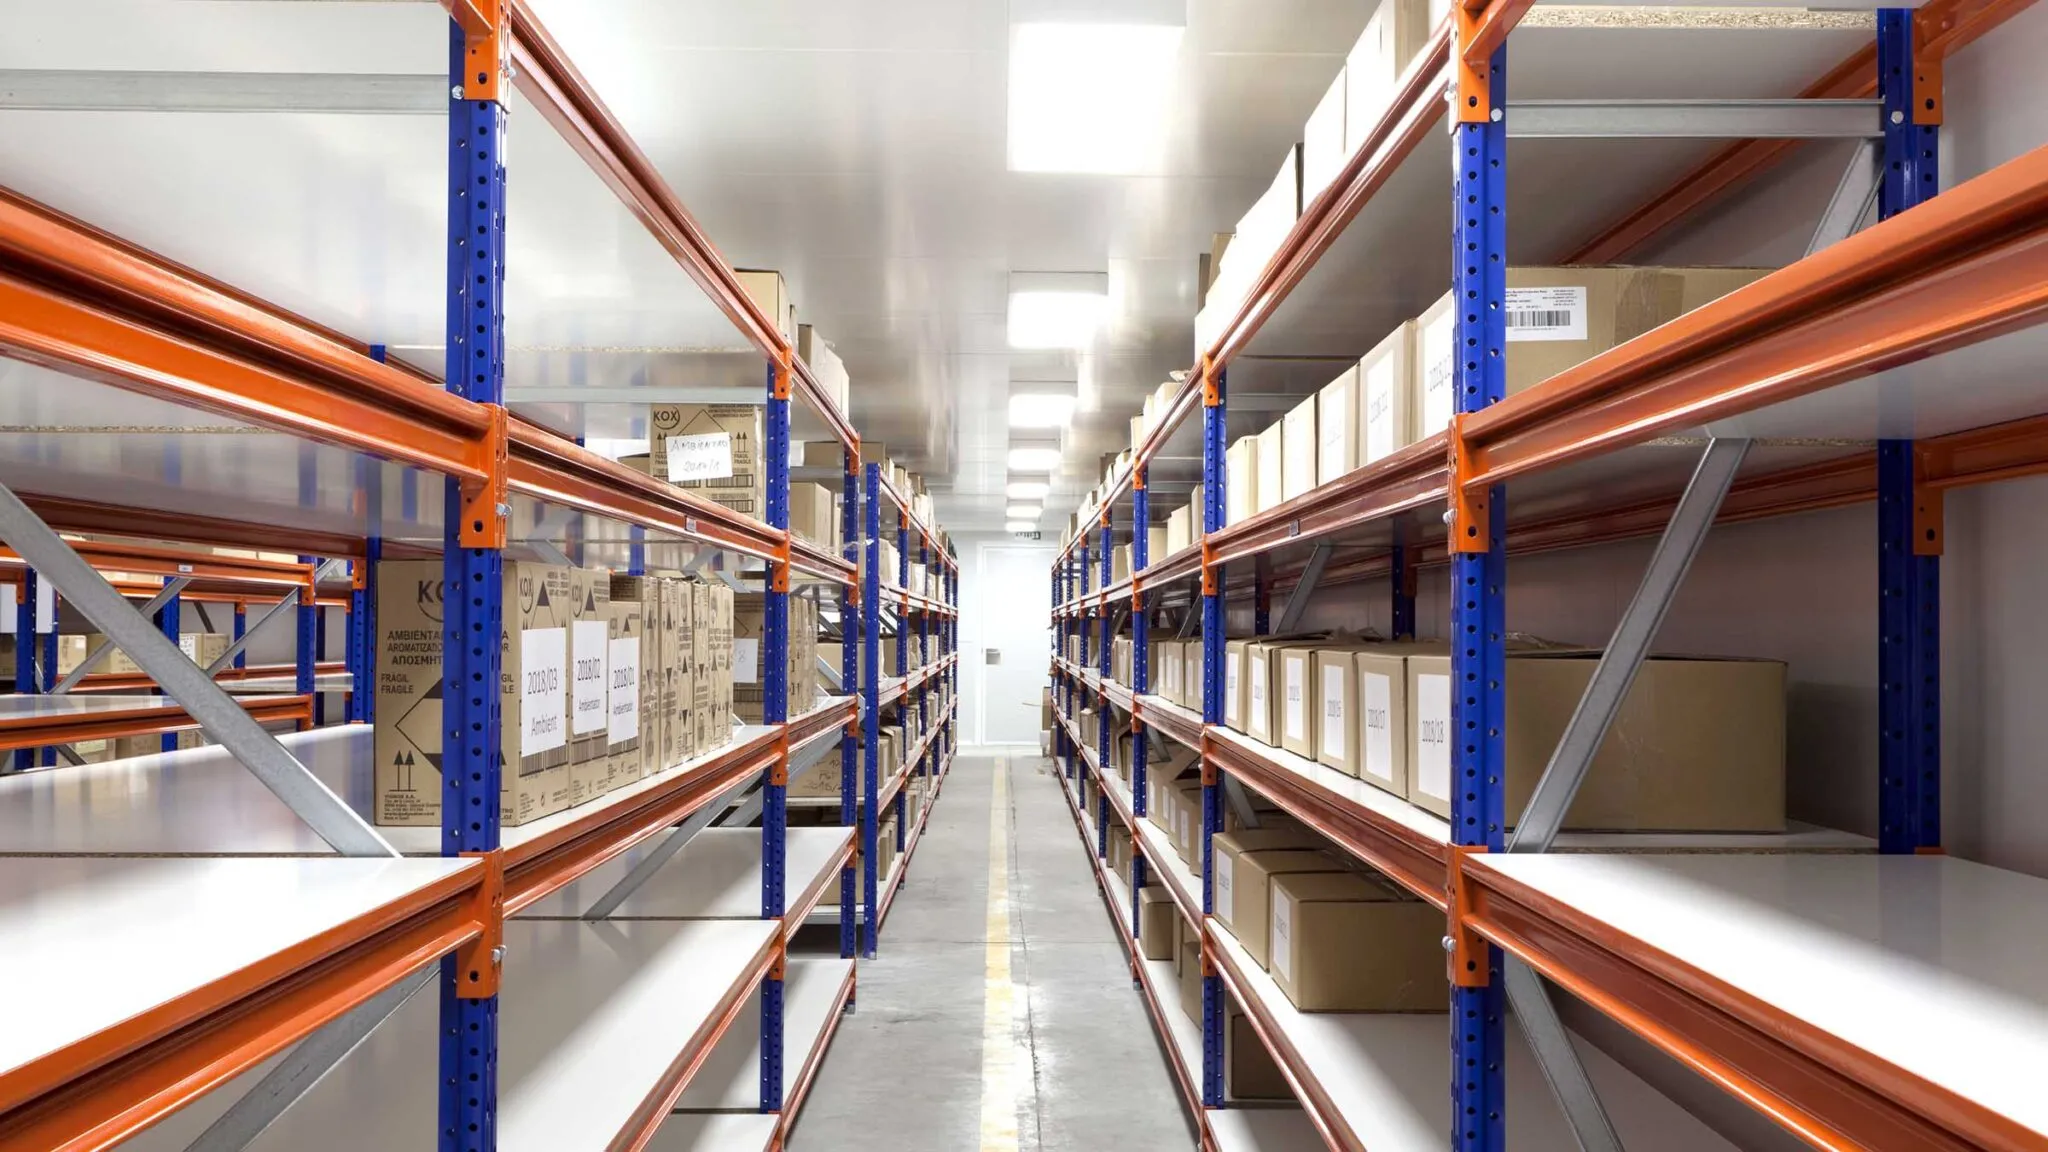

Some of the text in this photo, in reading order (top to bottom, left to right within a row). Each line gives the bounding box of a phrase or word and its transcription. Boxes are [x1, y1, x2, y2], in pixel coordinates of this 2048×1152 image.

[653, 410, 678, 422] KOX
[519, 576, 534, 599] KOX
[387, 630, 443, 641] AMBIENTA
[387, 642, 443, 653] AROMATIZADO
[391, 655, 443, 665] ΑΠΟΣΜΗΤ
[577, 657, 601, 683] 2018/02
[613, 665, 635, 690] 2018/01
[381, 684, 414, 695] FRAGILE
[527, 667, 558, 696] 2018/03
[530, 712, 558, 737] Ambient
